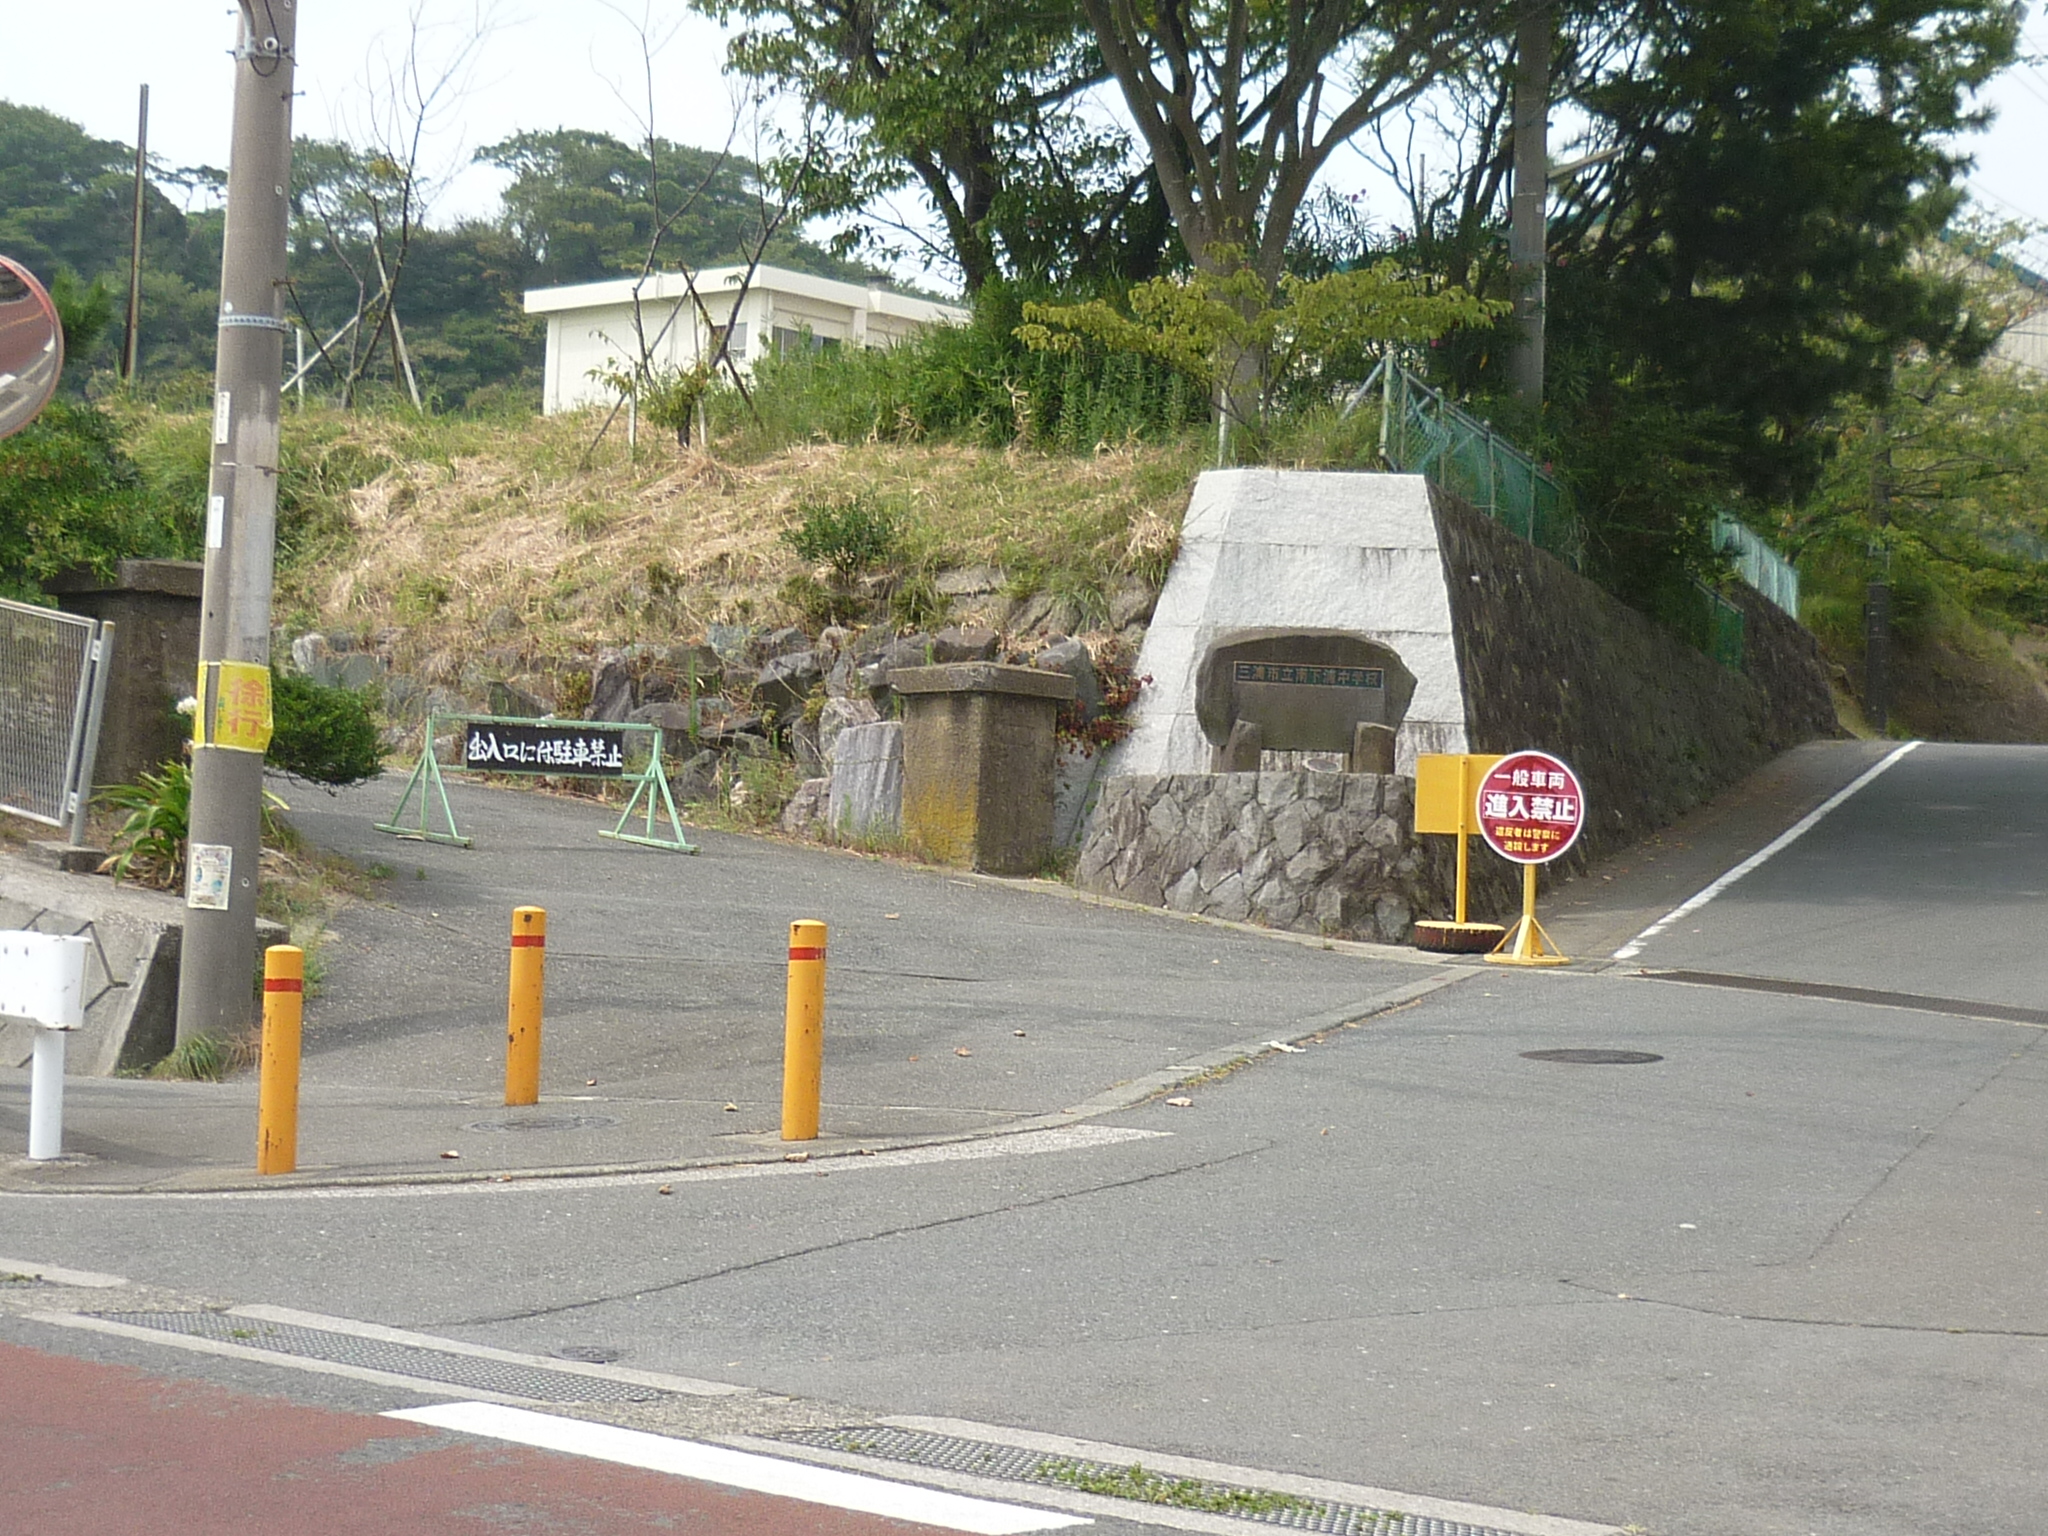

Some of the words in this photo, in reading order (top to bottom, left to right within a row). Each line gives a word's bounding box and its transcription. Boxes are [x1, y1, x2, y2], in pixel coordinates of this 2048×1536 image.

[226, 677, 265, 738] 徐行
[1494, 769, 1565, 790] 一般車両
[1485, 793, 1574, 821] 進入禁止
